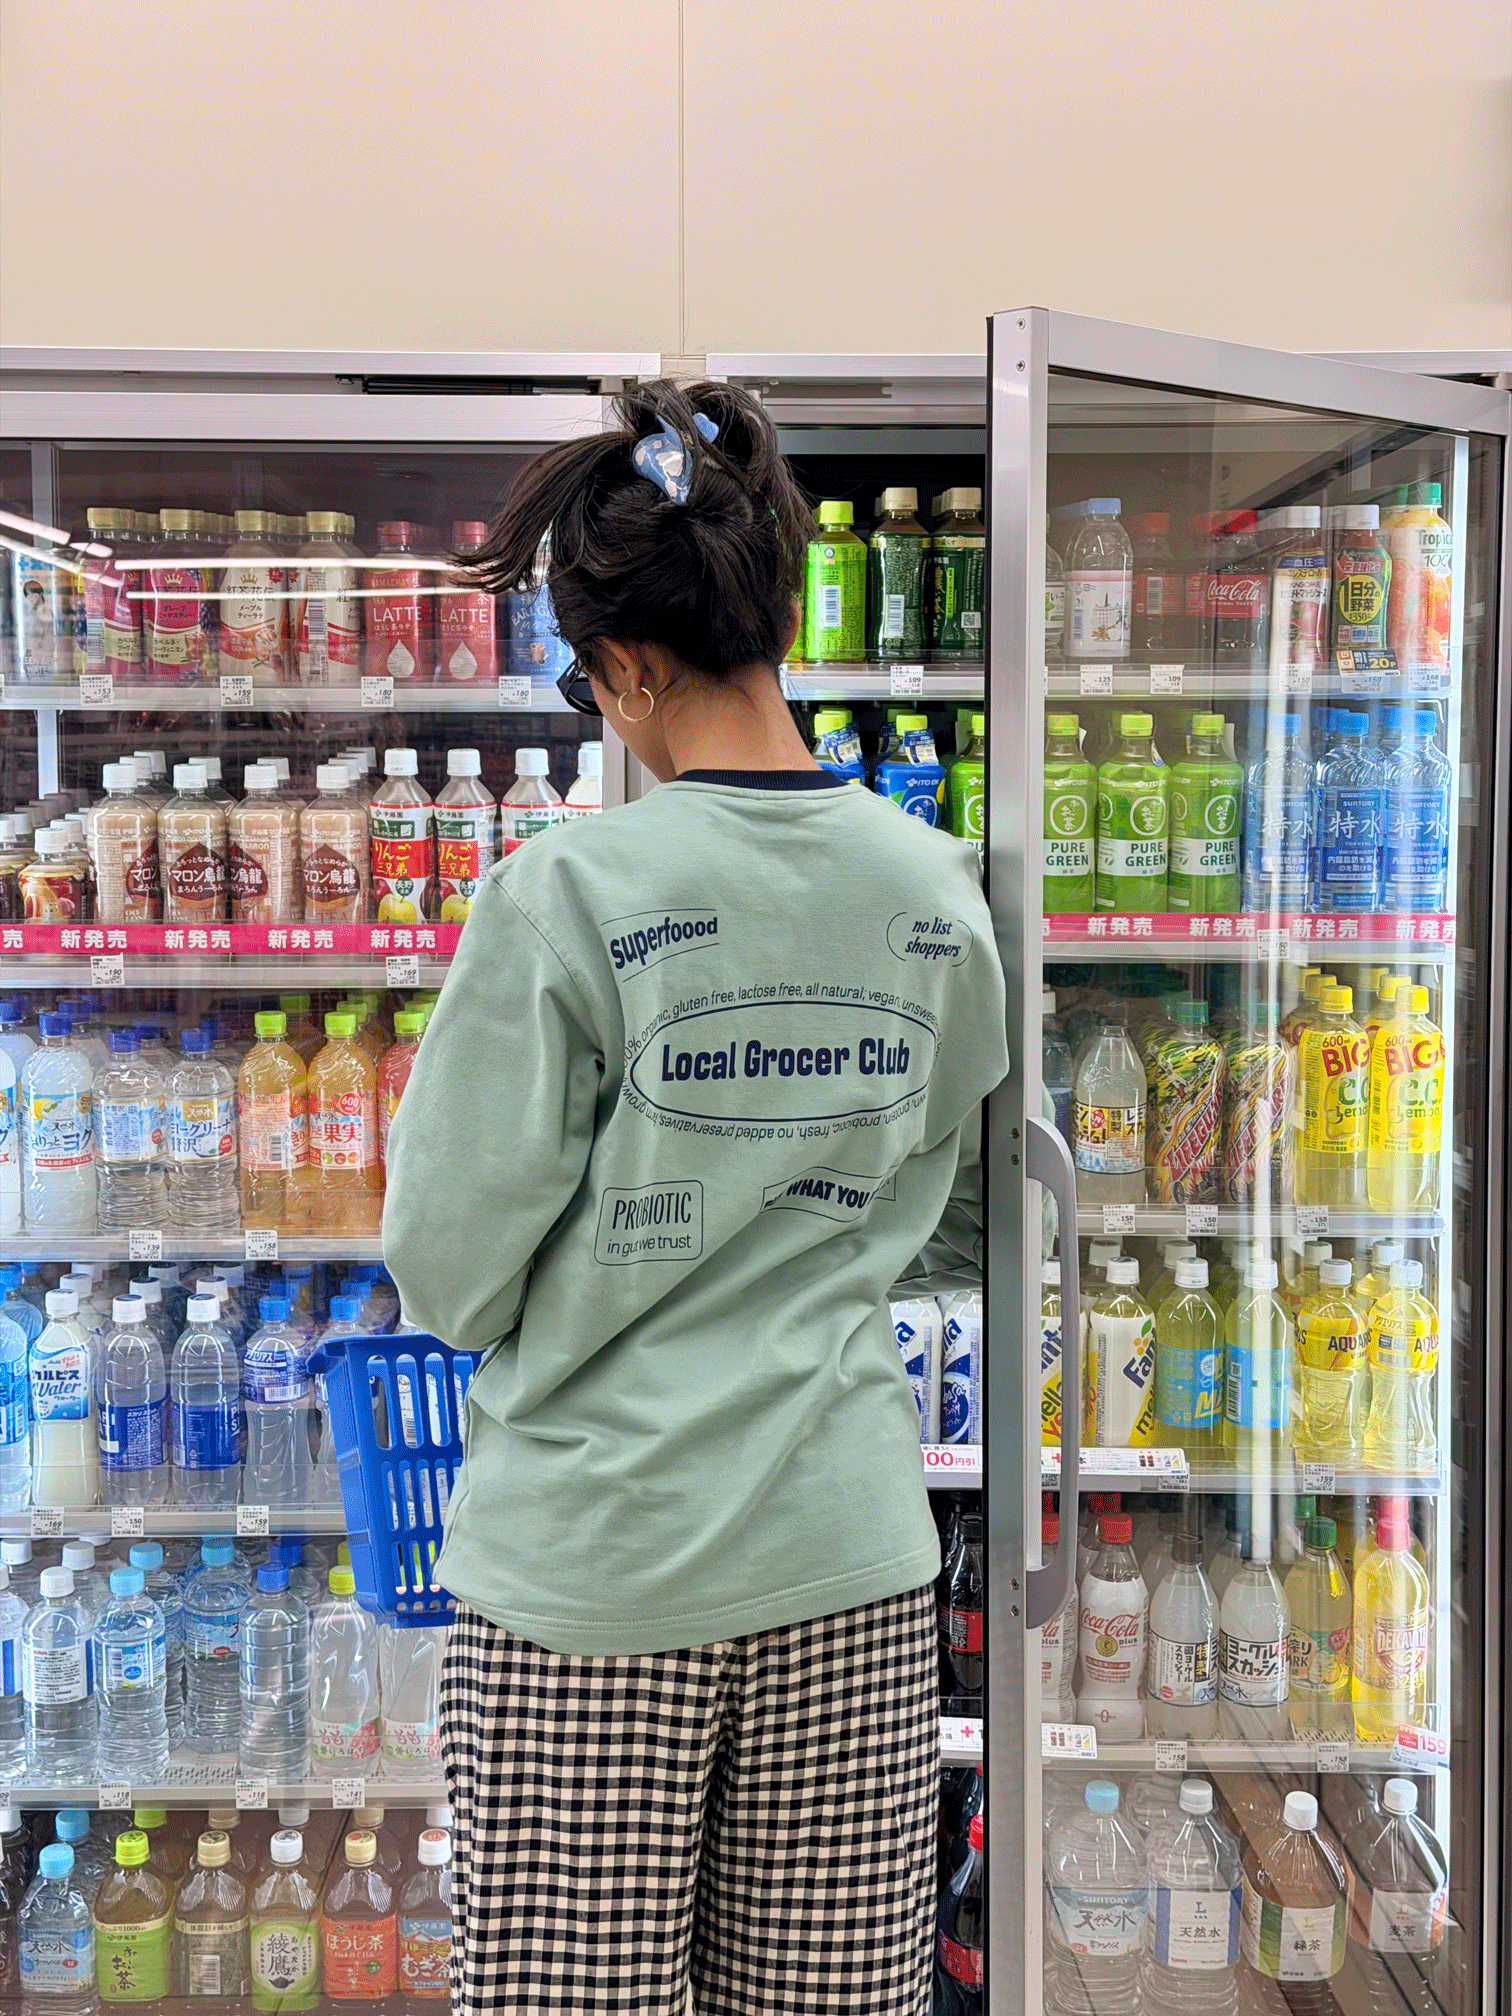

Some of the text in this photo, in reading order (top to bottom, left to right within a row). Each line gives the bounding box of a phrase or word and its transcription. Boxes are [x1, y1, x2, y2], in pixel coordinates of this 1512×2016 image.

[1416, 529, 1452, 548] Tropic
[1293, 556, 1314, 567] 血圧
[1207, 579, 1263, 603] Coca-Cola
[373, 606, 421, 623] LATTE
[1350, 598, 1375, 612] 野菜
[440, 608, 489, 624] LATTE
[1368, 676, 1381, 684] 150
[237, 689, 252, 697] 159
[379, 689, 392, 697] 180
[516, 689, 529, 697] 180
[1262, 809, 1313, 840] 特水
[1329, 809, 1382, 839] 特水
[1393, 810, 1448, 840] 特水
[373, 841, 412, 862] りんご
[438, 843, 473, 862] りんご
[1051, 842, 1085, 853] PURE
[1130, 841, 1164, 853] PURE
[1205, 840, 1235, 852] PURE
[376, 861, 408, 876] 三兄弟
[1046, 855, 1089, 867] GREEN
[1125, 854, 1167, 867] GREEN
[1199, 853, 1237, 866] GREEN
[171, 866, 226, 883] マロン烏龍
[303, 868, 356, 885] マロン烏龍
[439, 862, 470, 877] 三兄弟
[912, 917, 953, 936] no list
[1087, 917, 1153, 936] 新発売
[1189, 917, 1256, 937] 新発売
[1292, 918, 1359, 938] 新発売
[1396, 918, 1456, 938] 新発売
[3, 929, 24, 948] 売
[60, 929, 128, 948] 新発売
[164, 929, 231, 949] 新発売
[267, 929, 334, 949] 新発売
[370, 929, 436, 949] 新発売
[610, 916, 718, 969] superfoood
[905, 937, 962, 959] shoppers
[109, 968, 122, 976] 190
[672, 997, 709, 1019] gluten
[711, 990, 737, 1006] free,
[738, 984, 776, 1001] lactose
[778, 982, 803, 998] free,
[805, 982, 820, 997] all
[820, 985, 867, 1001] natural,
[868, 990, 901, 1008] vegan,
[661, 1037, 910, 1082] Local Grocer Club
[1321, 1038, 1369, 1078] BIG
[1385, 1039, 1438, 1077] BIG
[341, 1096, 359, 1107] 600
[1334, 1105, 1367, 1124] Lemo
[322, 1122, 362, 1144] 果実
[659, 1112, 735, 1140] preservatives,
[735, 1126, 775, 1141] added
[777, 1127, 794, 1139] no
[796, 1124, 830, 1141] fresh,
[785, 1178, 835, 1201] WHAT
[612, 1191, 692, 1231] PROBIOTIC
[607, 1238, 620, 1255] in
[638, 1235, 656, 1251] we
[657, 1233, 692, 1250] trust
[1122, 1326, 1157, 1389] Fan
[1319, 1475, 1333, 1483] 159
[48, 1520, 62, 1528] 169
[254, 1519, 267, 1527] 159
[1080, 1607, 1142, 1638] Coca-Cola
[1118, 1637, 1138, 1647] plus
[1419, 1735, 1448, 1756] 159
[1173, 1753, 1186, 1761] 158
[1082, 1896, 1130, 1905] SUNTORY
[1073, 1909, 1137, 1932] 天然水
[1179, 1926, 1221, 1938] 天然水
[1387, 1925, 1416, 1938] 麦茶
[326, 1934, 384, 1951] ほうじ茶
[1293, 1939, 1322, 1951] 緑茶
[267, 1933, 292, 1976] 綾鷹
[401, 1953, 451, 1978] むぎ茶
